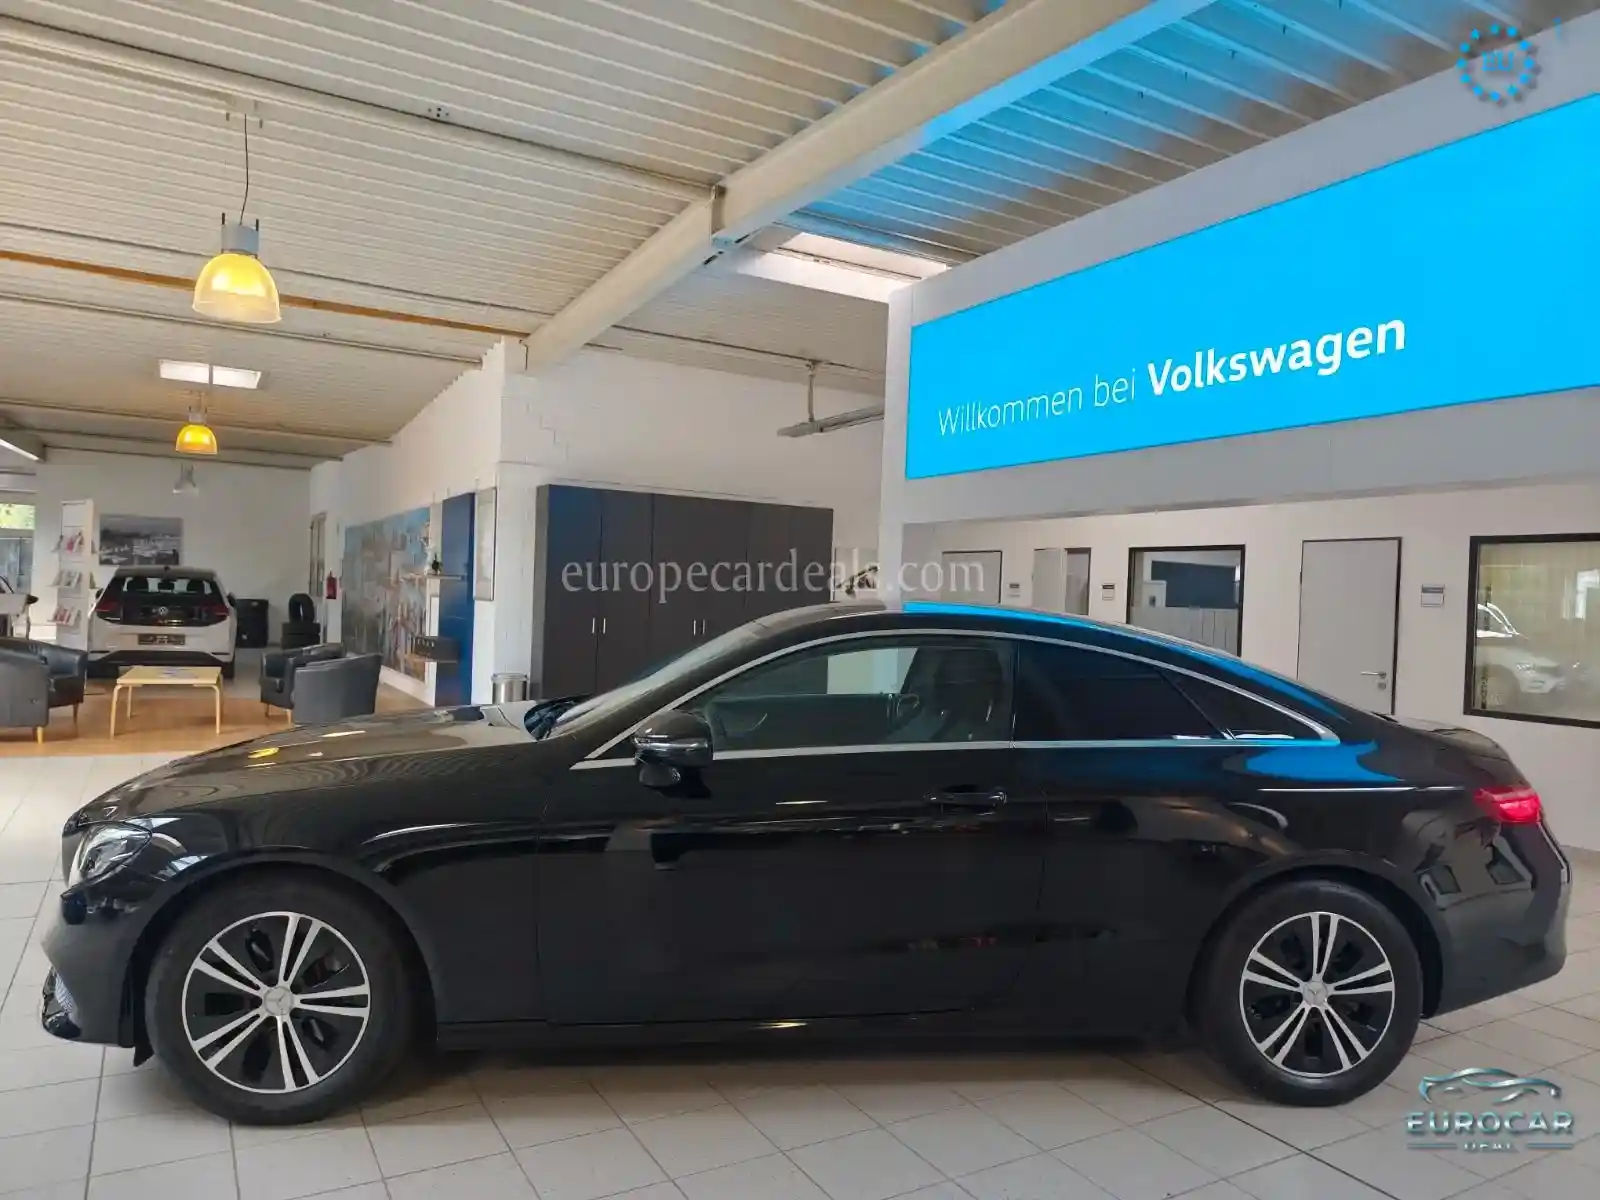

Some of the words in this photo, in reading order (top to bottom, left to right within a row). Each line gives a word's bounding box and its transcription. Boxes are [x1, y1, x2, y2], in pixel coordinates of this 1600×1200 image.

[938, 384, 1083, 436] Willkommen
[1094, 369, 1136, 407] bei
[1146, 318, 1406, 395] Volkswagen
